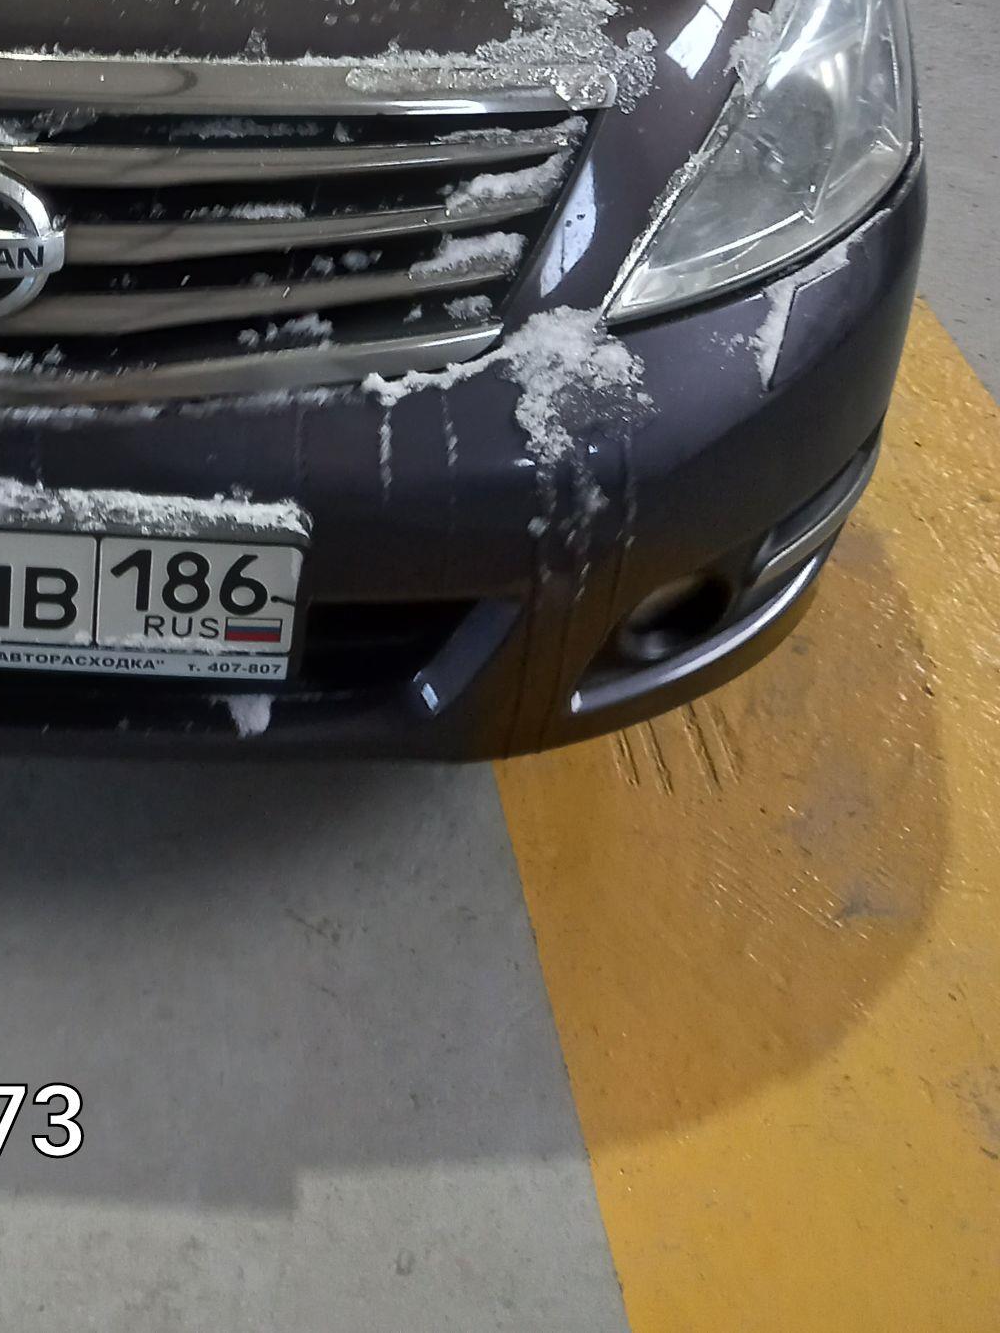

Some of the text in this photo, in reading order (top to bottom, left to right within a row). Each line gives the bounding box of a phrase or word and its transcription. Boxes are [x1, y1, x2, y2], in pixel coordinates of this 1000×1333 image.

[110, 549, 268, 615] 186
[144, 615, 220, 639] RUS
[207, 662, 282, 675] 407-807
